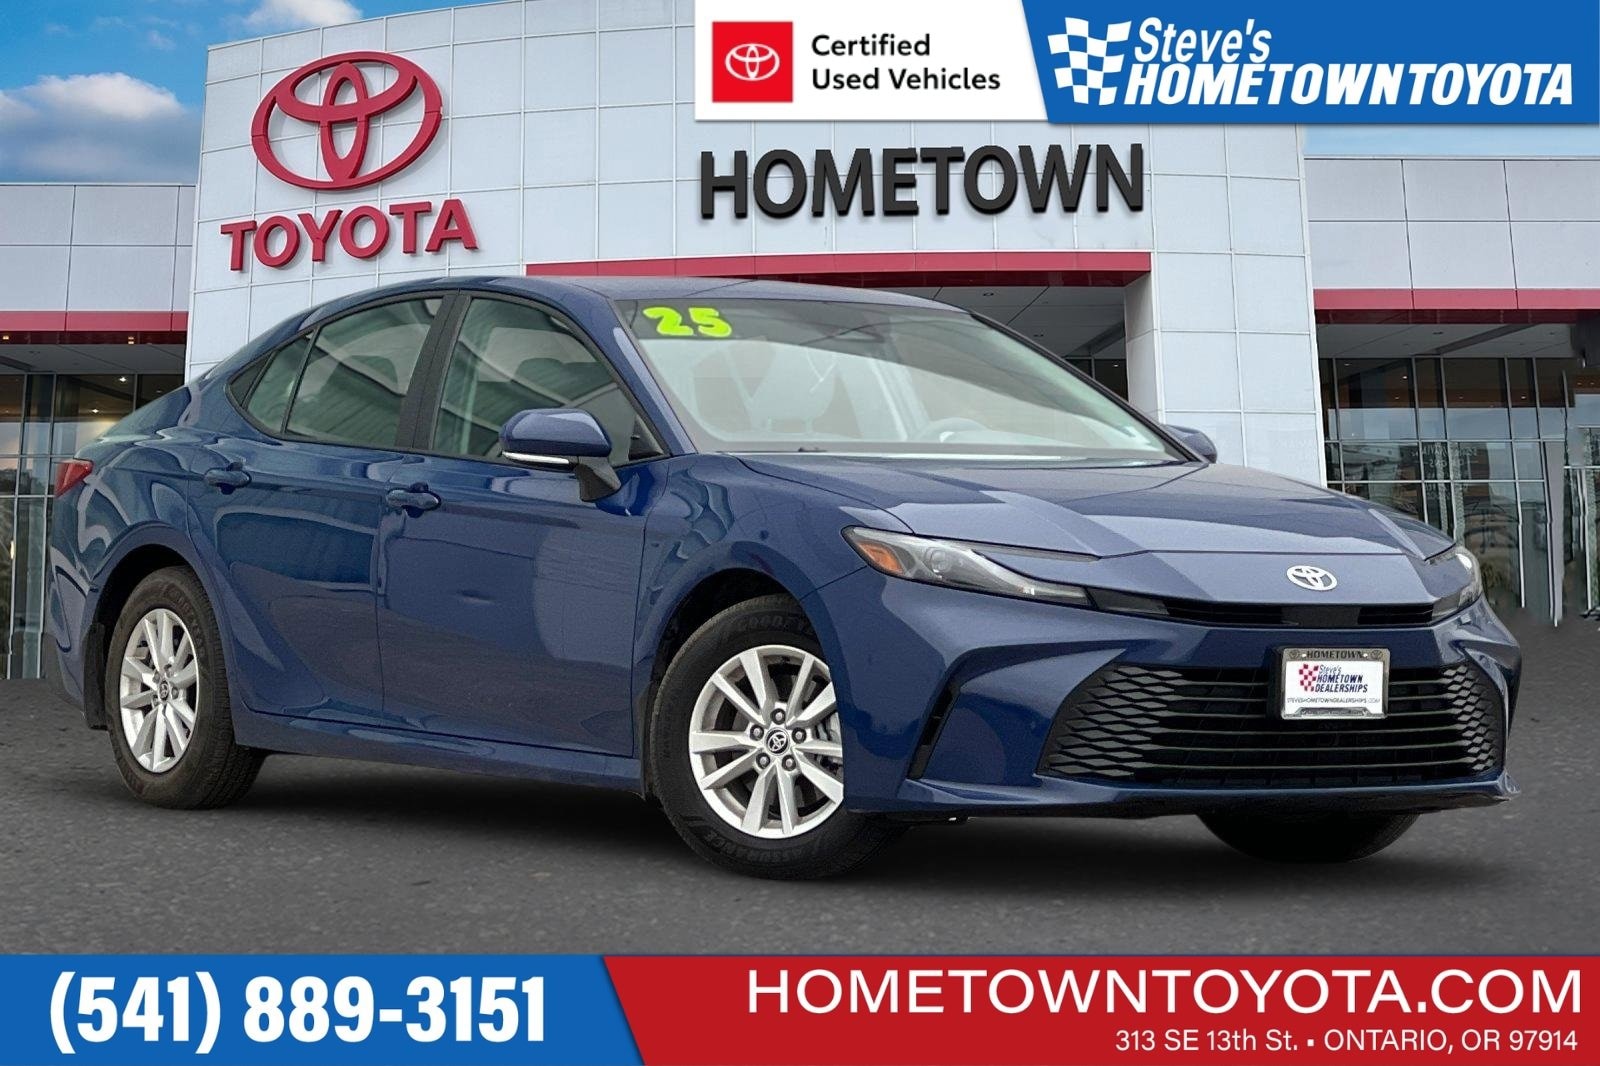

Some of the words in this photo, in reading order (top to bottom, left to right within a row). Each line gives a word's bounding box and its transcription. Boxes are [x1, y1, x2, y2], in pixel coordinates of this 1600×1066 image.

[701, 144, 1145, 219] HOMETOWN
[221, 198, 478, 271] TOYOTA
[643, 306, 732, 339] 25
[1307, 650, 1363, 659] HOMETOWN
[1319, 664, 1341, 674] Steve's
[1316, 674, 1363, 683] HOMETOWN
[1315, 683, 1368, 693] DEALERSHIPS
